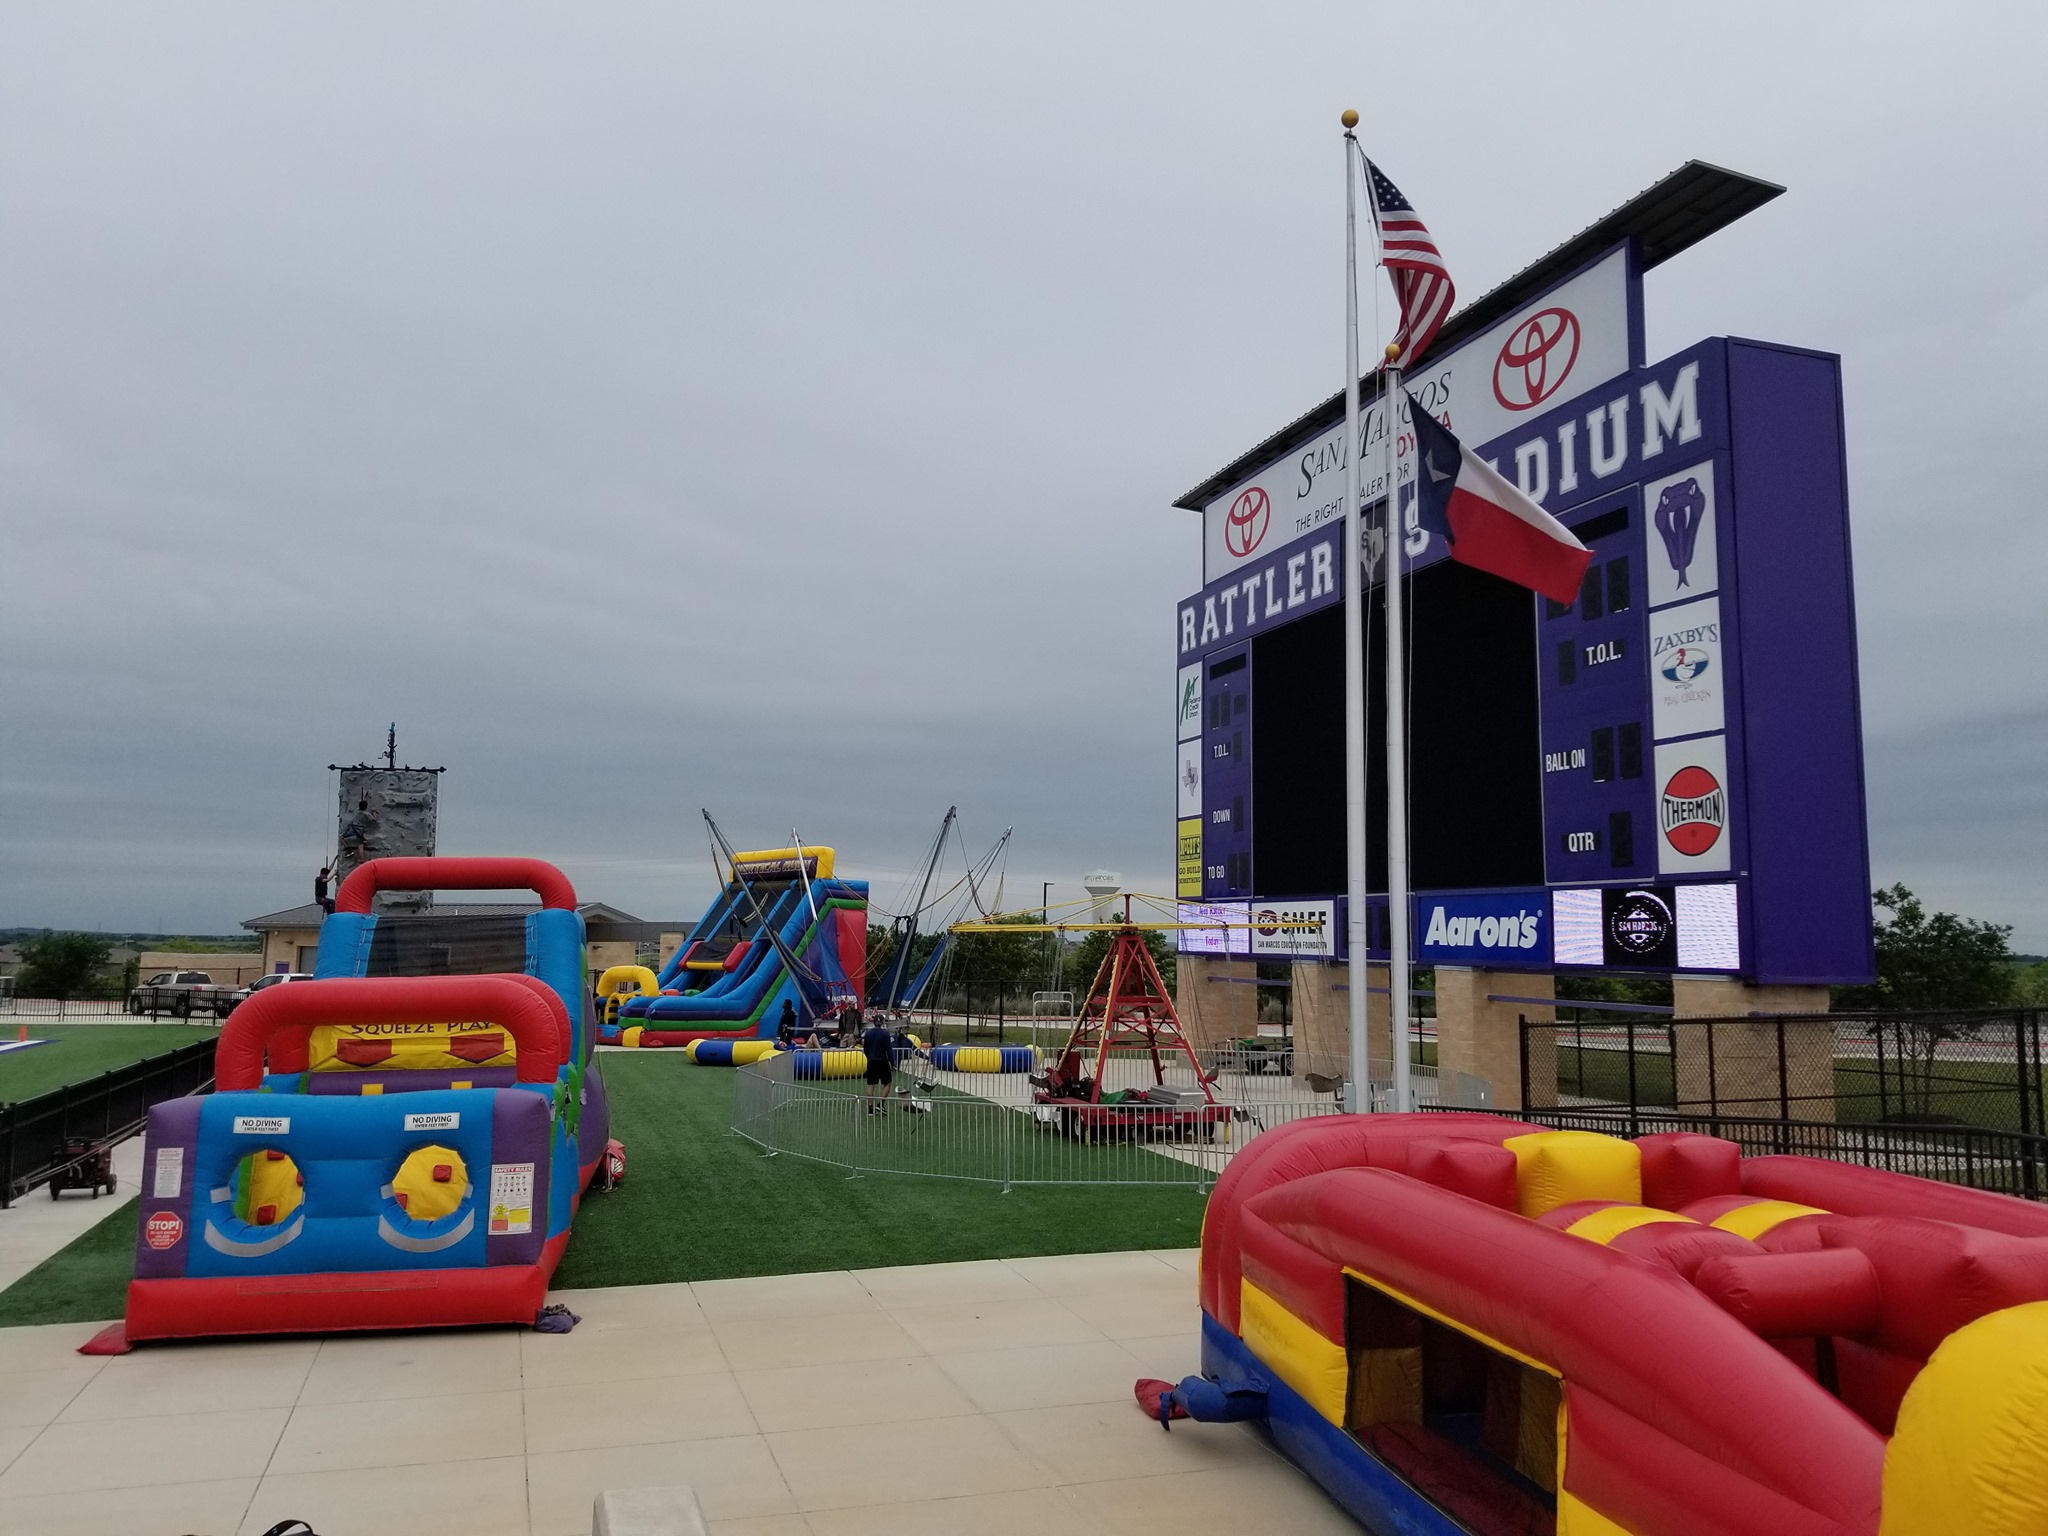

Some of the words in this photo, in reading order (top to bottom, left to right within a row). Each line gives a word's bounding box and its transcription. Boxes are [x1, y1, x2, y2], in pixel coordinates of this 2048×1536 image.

[1297, 436, 1344, 501] SAN
[1181, 540, 1334, 655] RATTLER
[1404, 360, 1702, 559] SDIUM
[1295, 516, 1311, 533] THE
[1314, 496, 1344, 525] RIGHT
[1360, 476, 1383, 499] ALER
[1654, 623, 1719, 658] ZAXBY'S
[1586, 641, 1622, 666] T.O.L.
[1213, 743, 1229, 758] T.O.L.
[1546, 753, 1570, 773] BALL
[1571, 748, 1586, 769] ON
[1212, 808, 1231, 824] DOWN
[1664, 791, 1721, 828] THERMON
[1568, 832, 1595, 853] QTR
[1207, 866, 1216, 879] TO
[1216, 865, 1225, 879] GO
[1424, 906, 1538, 949] Aaron's
[351, 1023, 435, 1035] SQUEEZE
[447, 1021, 490, 1032] PLAY
[242, 1119, 255, 1127] NO
[256, 1119, 283, 1127] DIVING
[412, 1116, 425, 1124] NO
[425, 1115, 452, 1123] DIVING
[149, 1220, 180, 1230] STOP!
